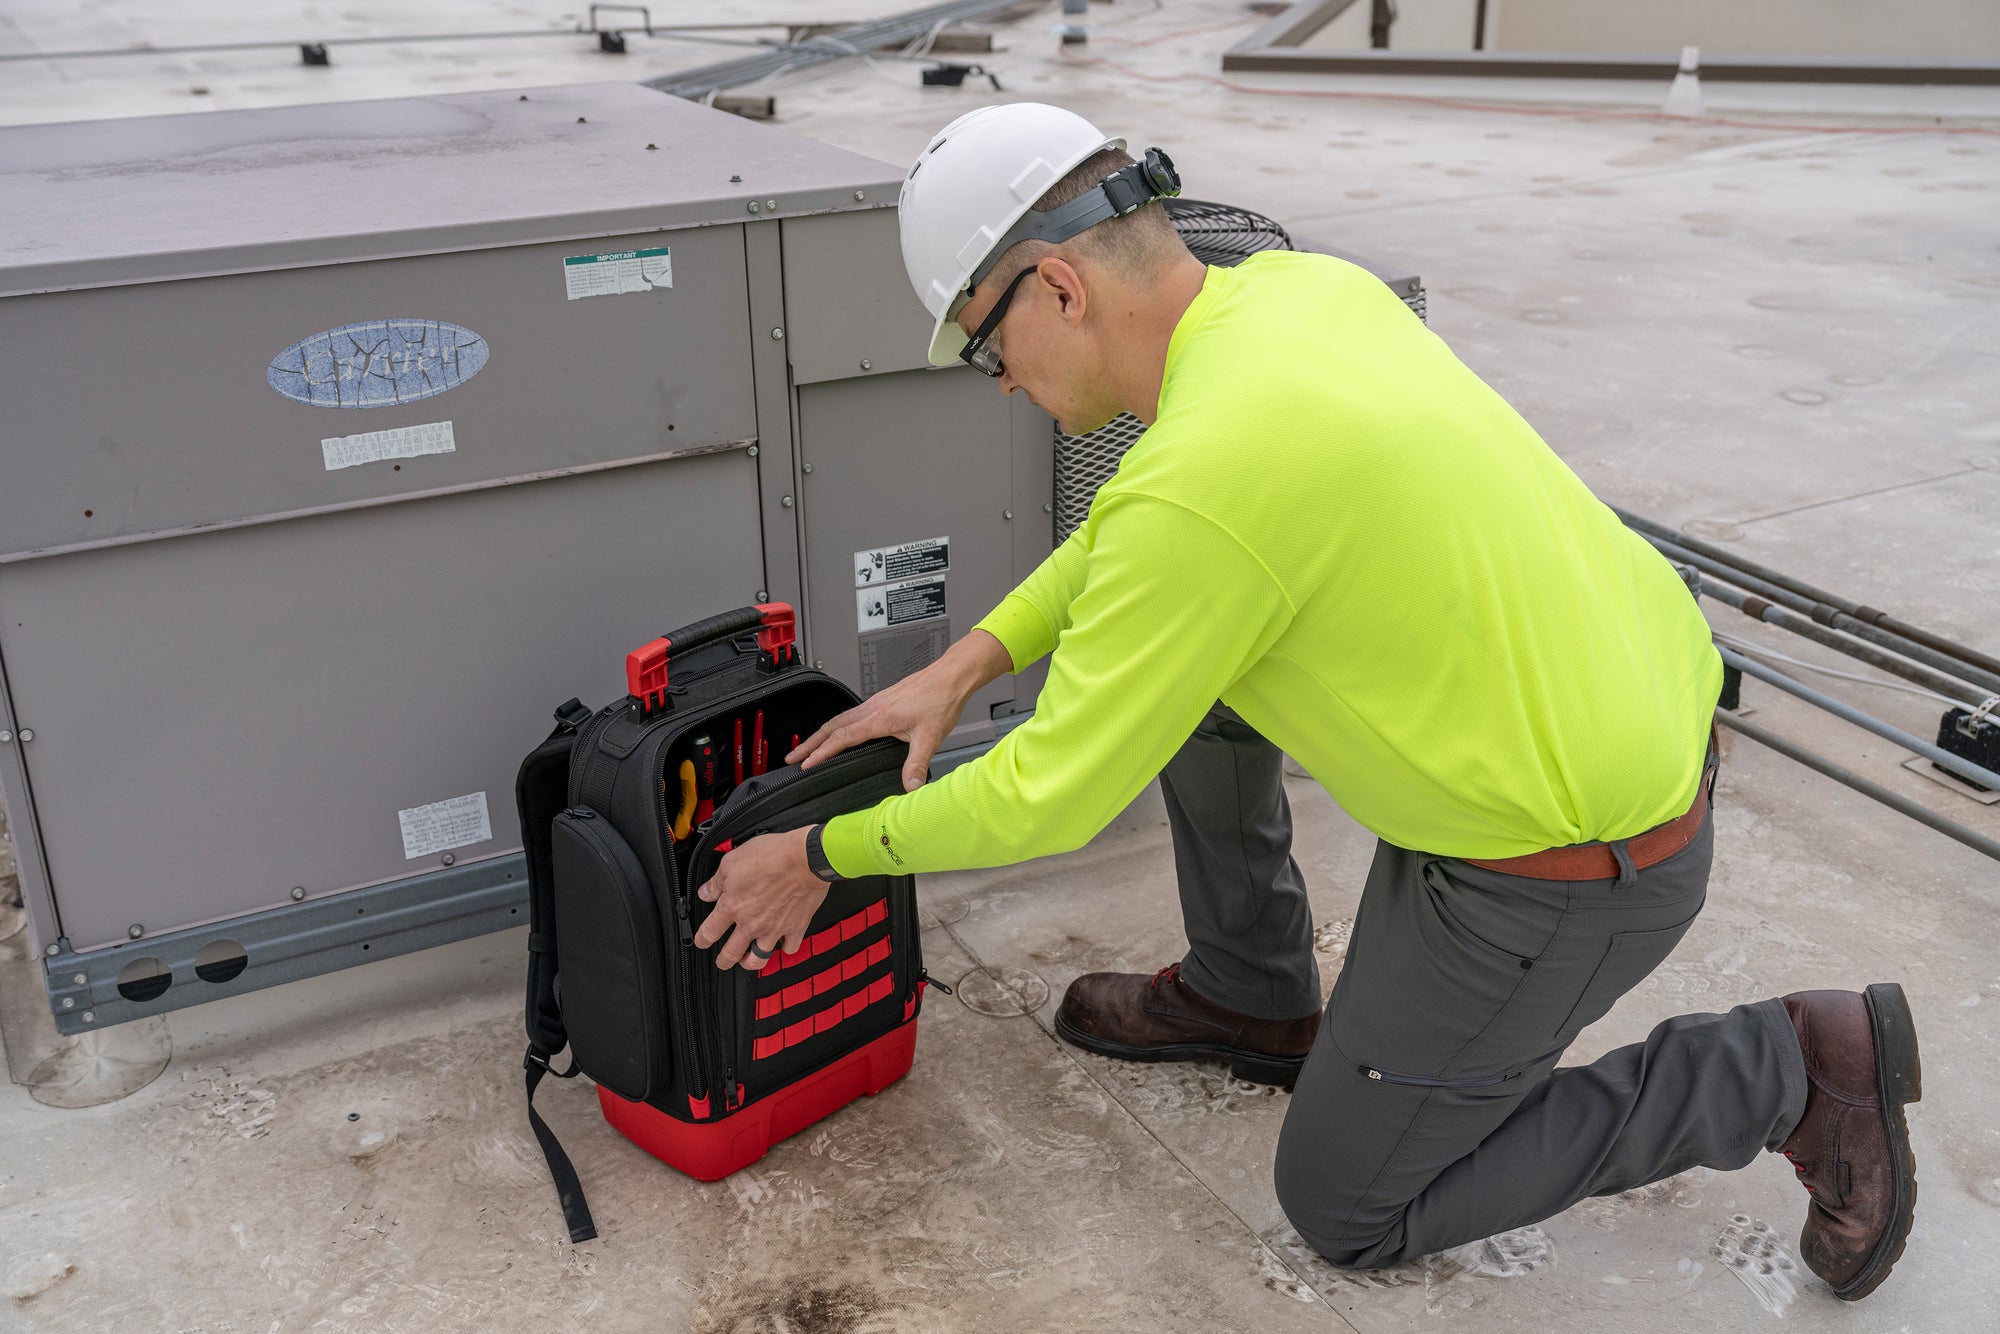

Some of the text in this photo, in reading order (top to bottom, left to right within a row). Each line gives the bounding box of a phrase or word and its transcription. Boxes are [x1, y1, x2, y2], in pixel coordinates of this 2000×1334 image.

[597, 252, 637, 262] IMPORTANT
[303, 342, 457, 385] Carrier
[904, 540, 937, 551] WARNING
[906, 578, 934, 587] WARNING
[704, 761, 714, 786] wiha
[881, 825, 905, 866] FORCE
